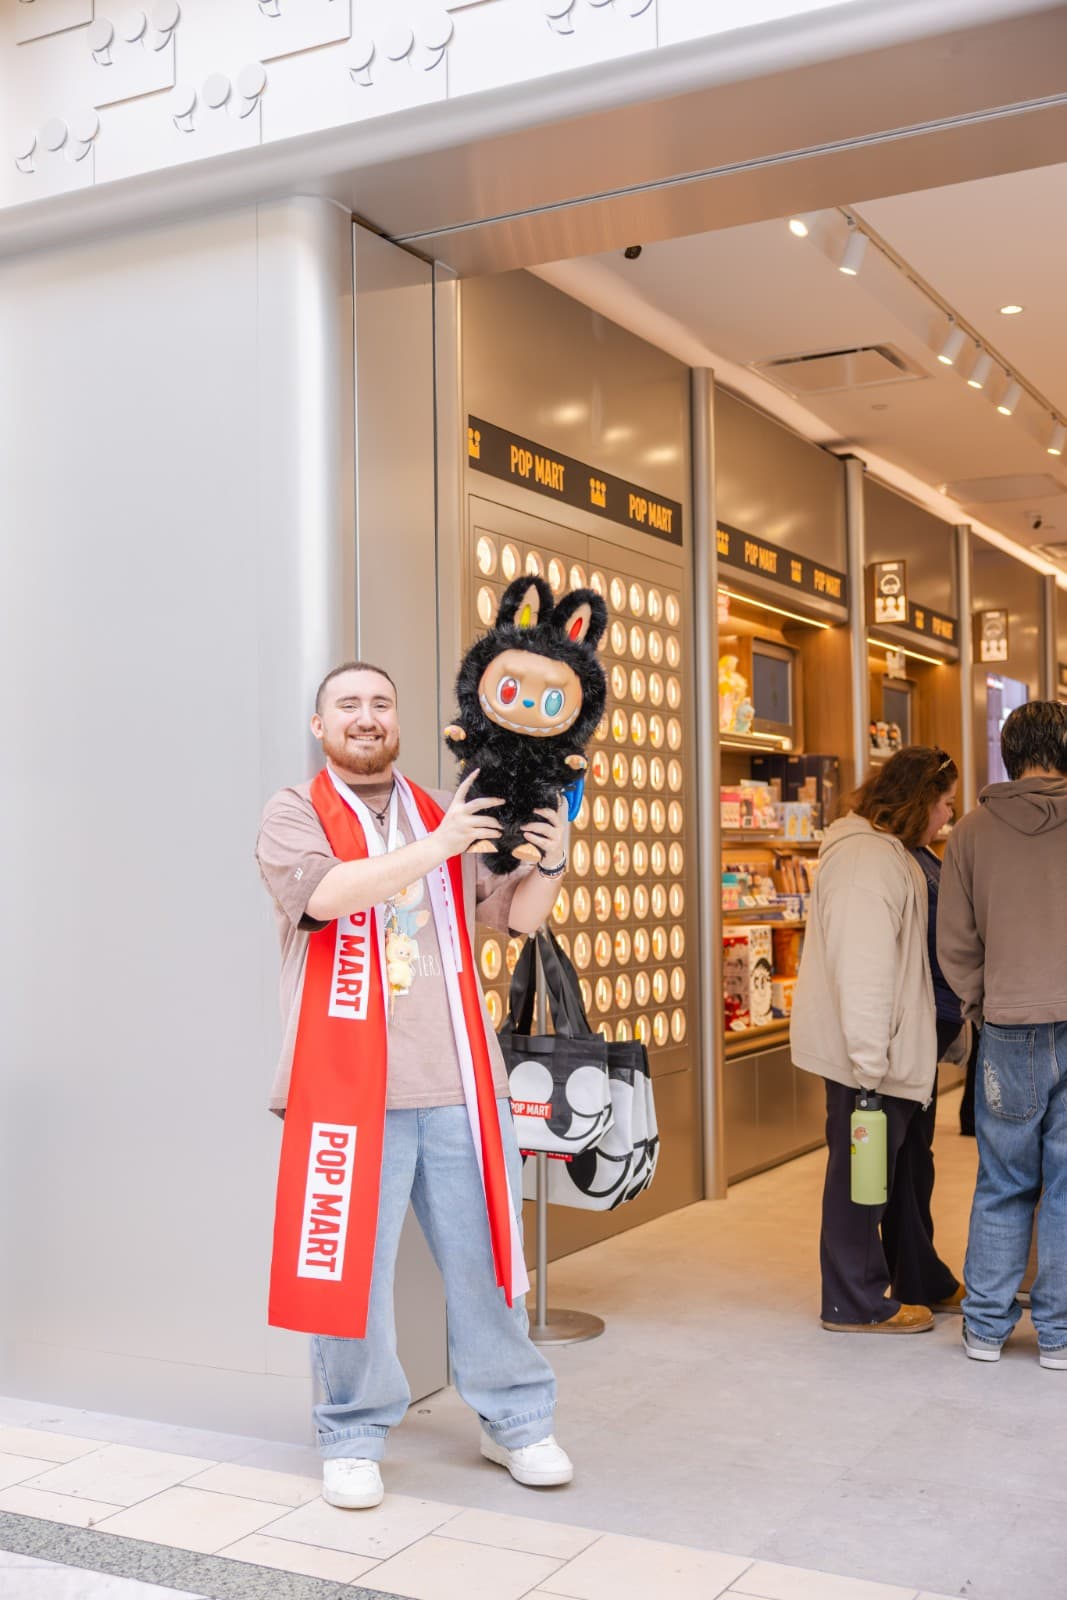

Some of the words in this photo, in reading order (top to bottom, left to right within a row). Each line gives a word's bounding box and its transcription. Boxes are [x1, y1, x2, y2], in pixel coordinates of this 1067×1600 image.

[510, 444, 533, 478] POP
[535, 456, 565, 492] MART
[629, 493, 648, 524] POP
[648, 502, 673, 533] MART
[335, 934, 366, 1012] MART
[409, 955, 441, 977] STERS
[526, 1104, 549, 1117] MART
[314, 1130, 349, 1186] POP
[305, 1193, 343, 1273] MART
